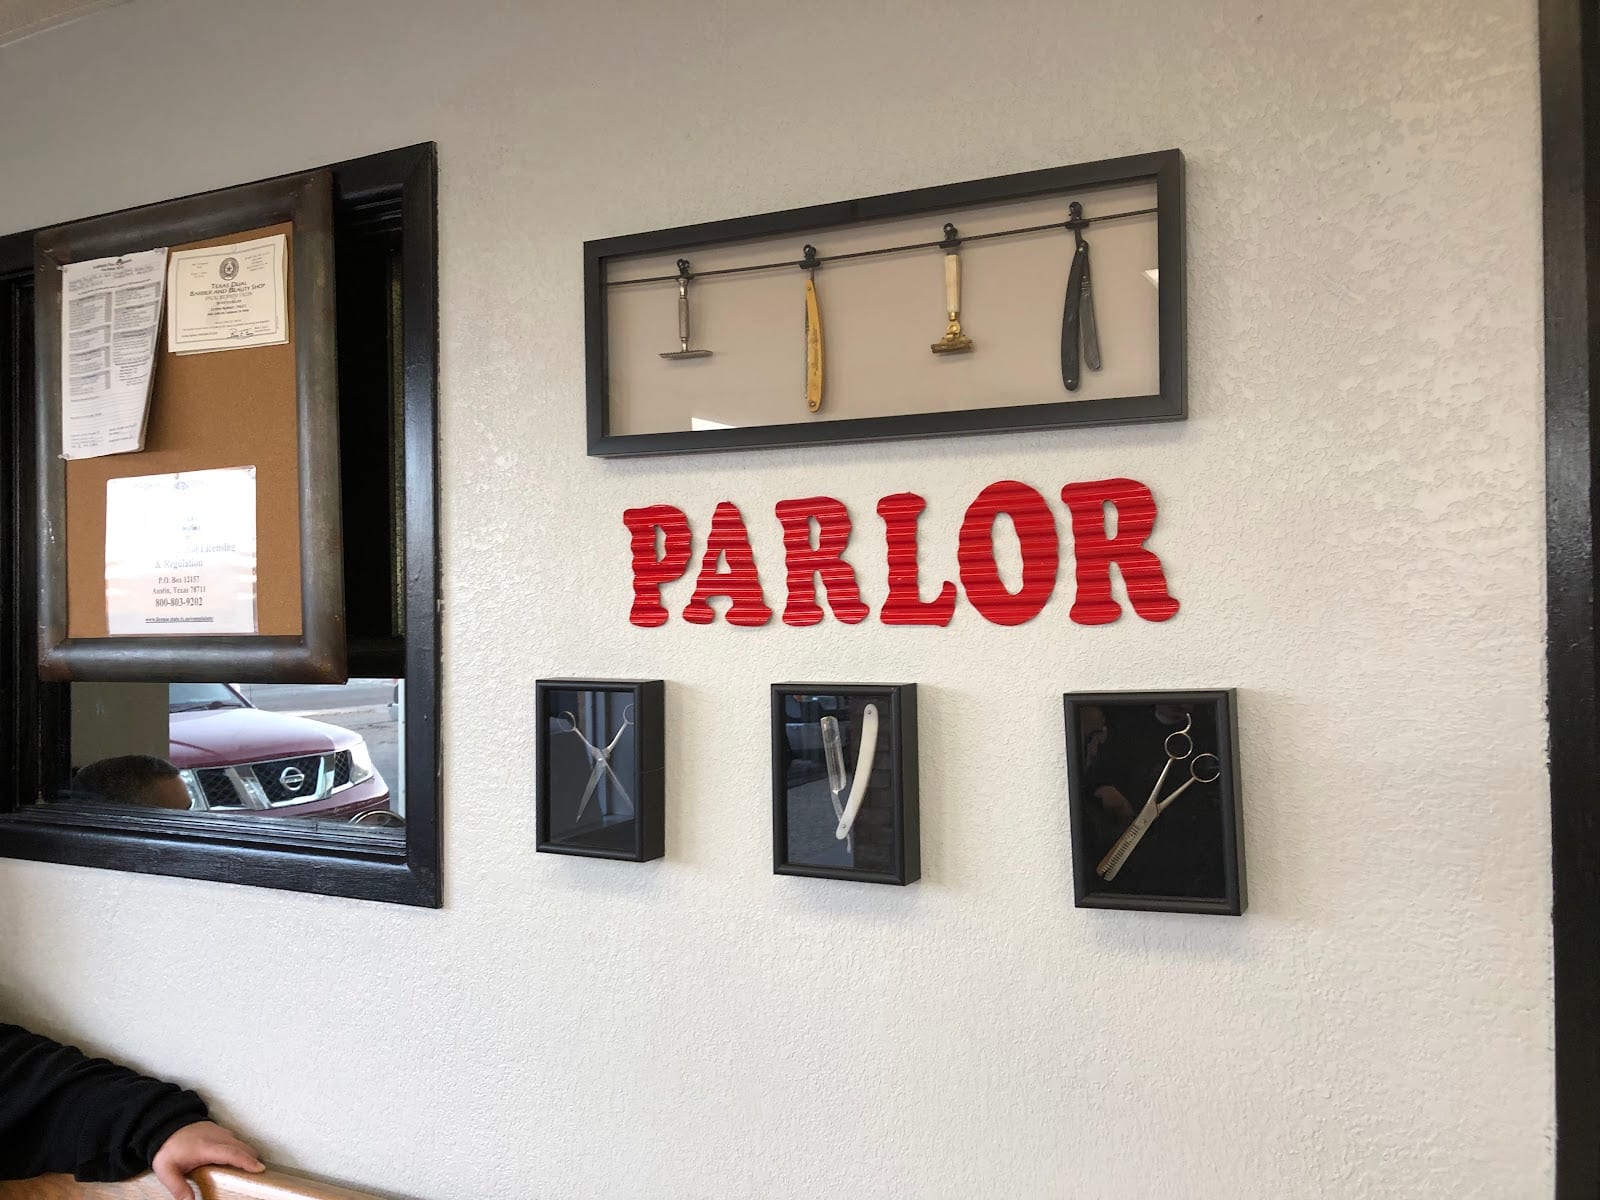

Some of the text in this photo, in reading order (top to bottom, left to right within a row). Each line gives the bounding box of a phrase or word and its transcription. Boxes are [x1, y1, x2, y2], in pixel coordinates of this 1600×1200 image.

[623, 477, 1180, 627] PARLOR
[164, 558, 204, 570] Regulation
[173, 586, 188, 594] Texas
[155, 596, 203, 607] 800-803-9202
